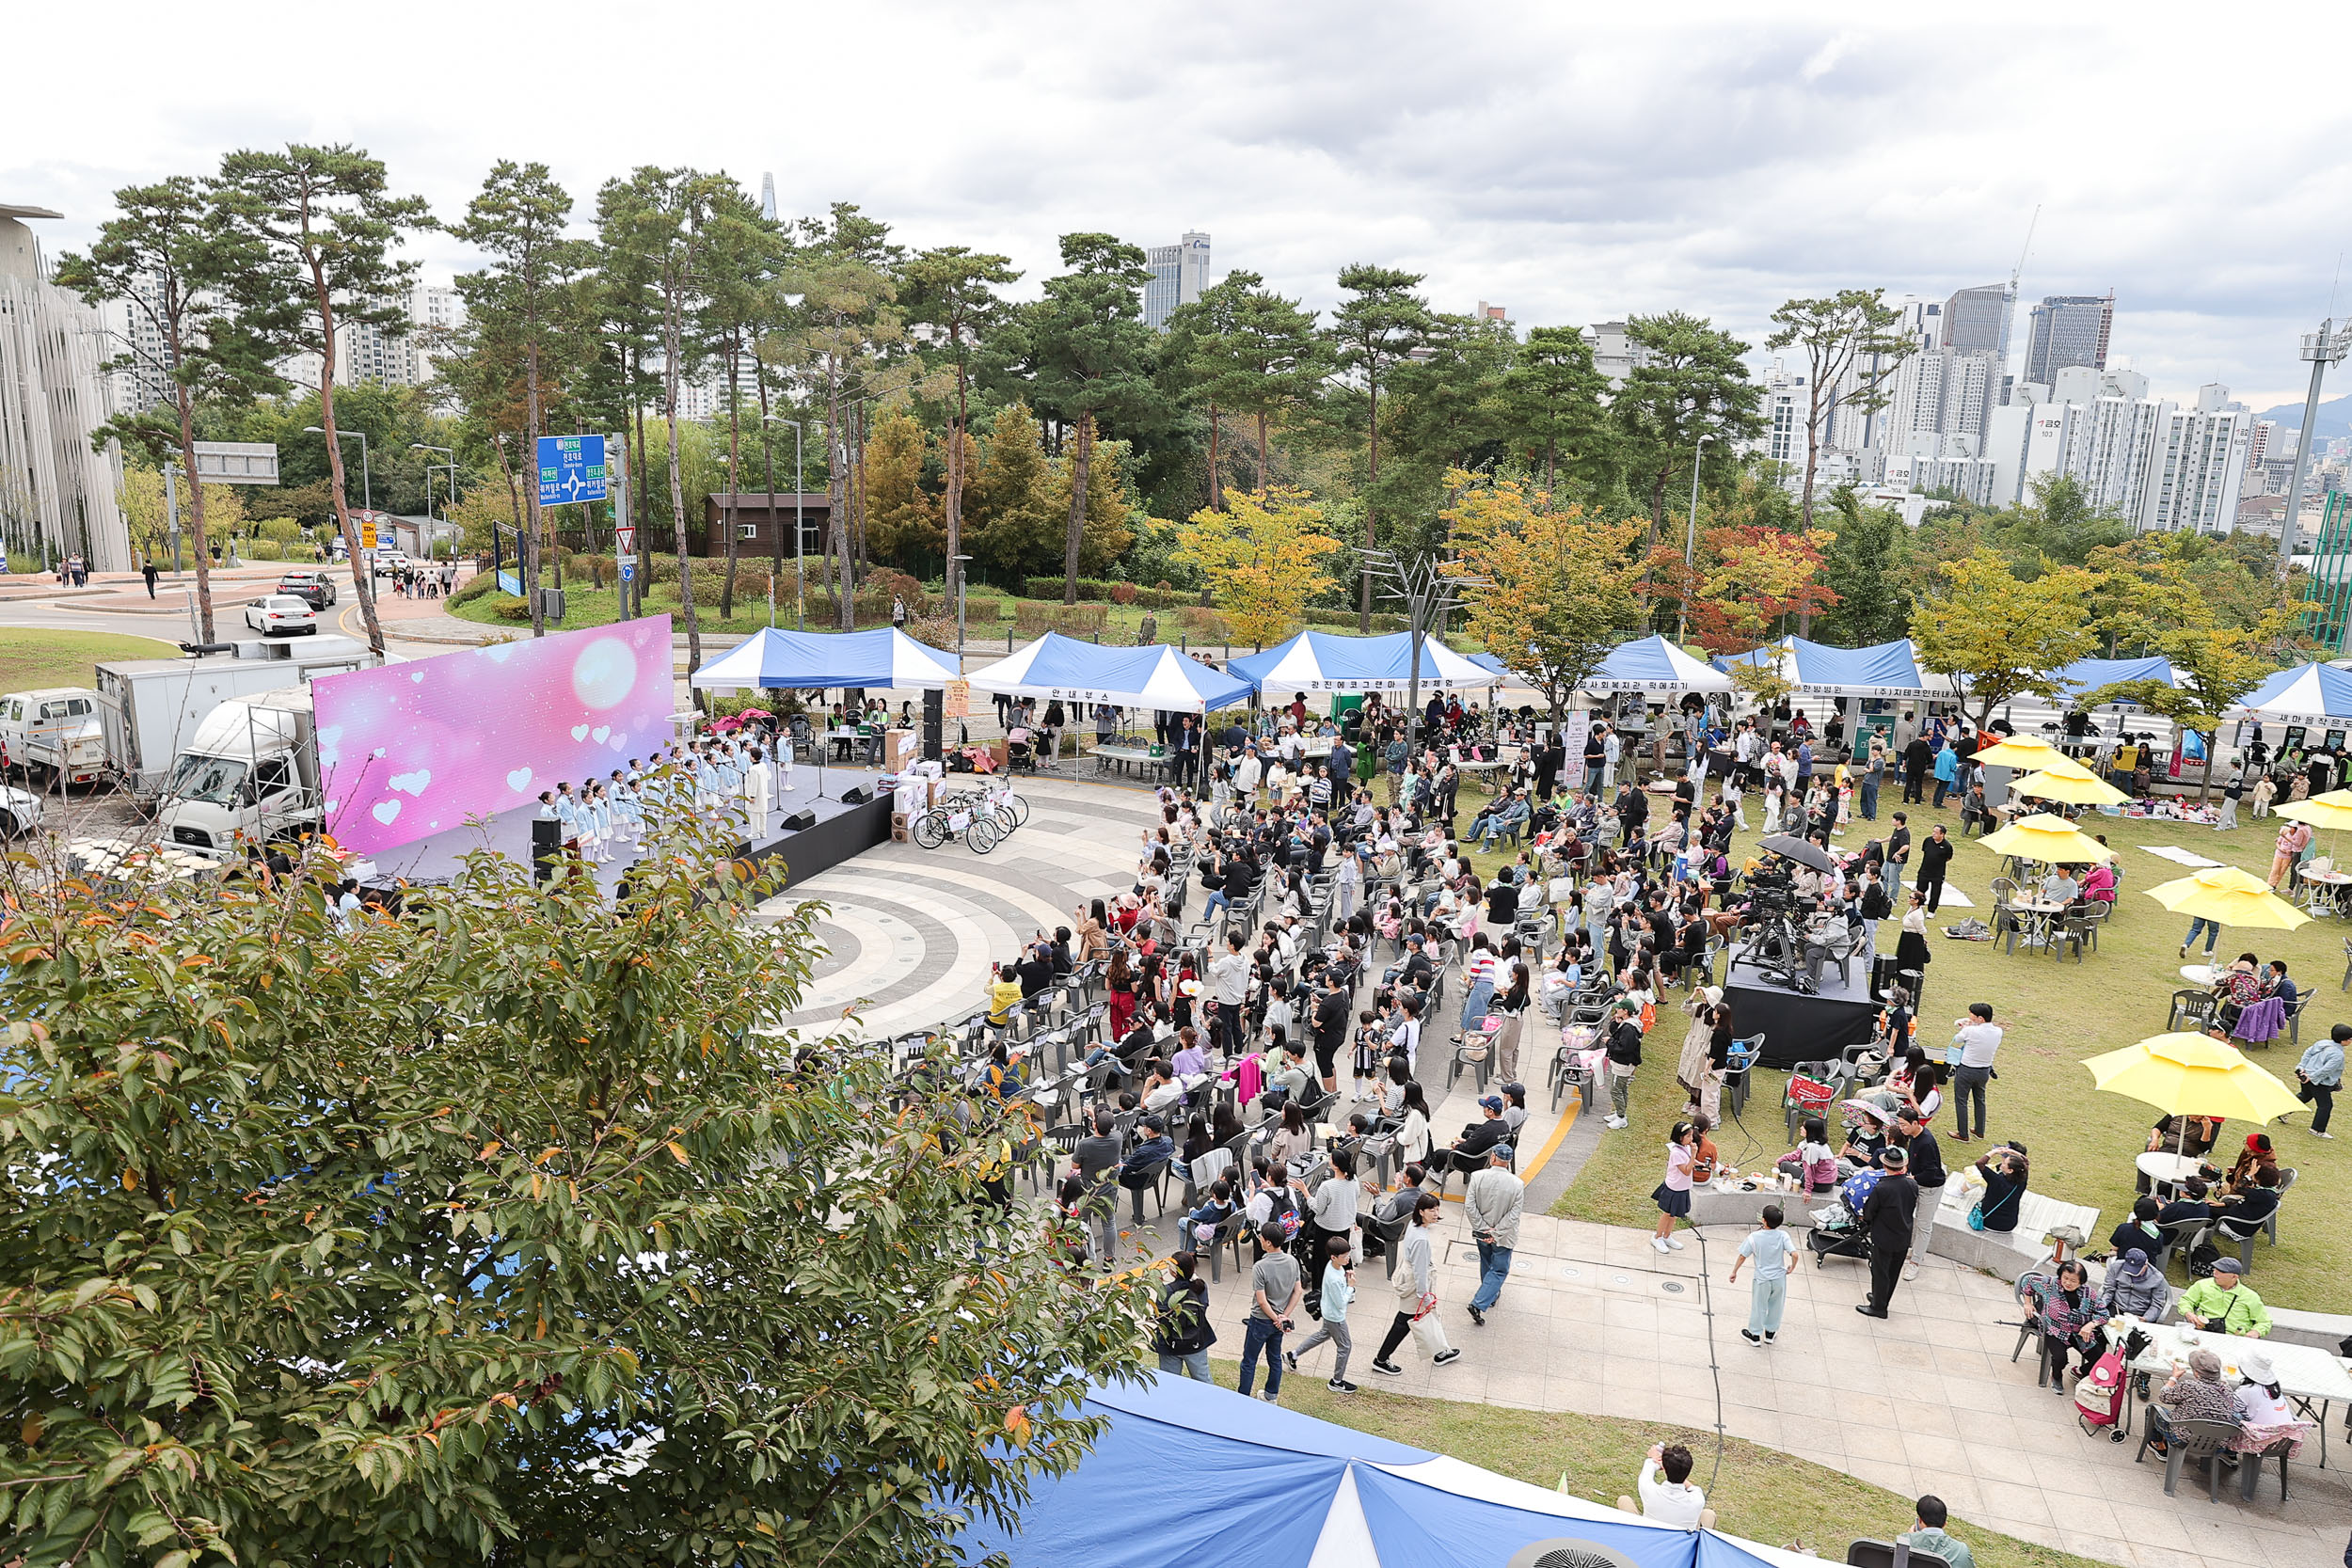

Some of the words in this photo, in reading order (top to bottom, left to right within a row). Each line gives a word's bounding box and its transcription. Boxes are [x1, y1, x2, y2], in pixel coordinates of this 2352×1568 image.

[2045, 420, 2061, 428] 금호
[1896, 469, 1910, 478] 금호
[1407, 679, 1454, 689] 경체험
[1052, 689, 1108, 702] 안내부스
